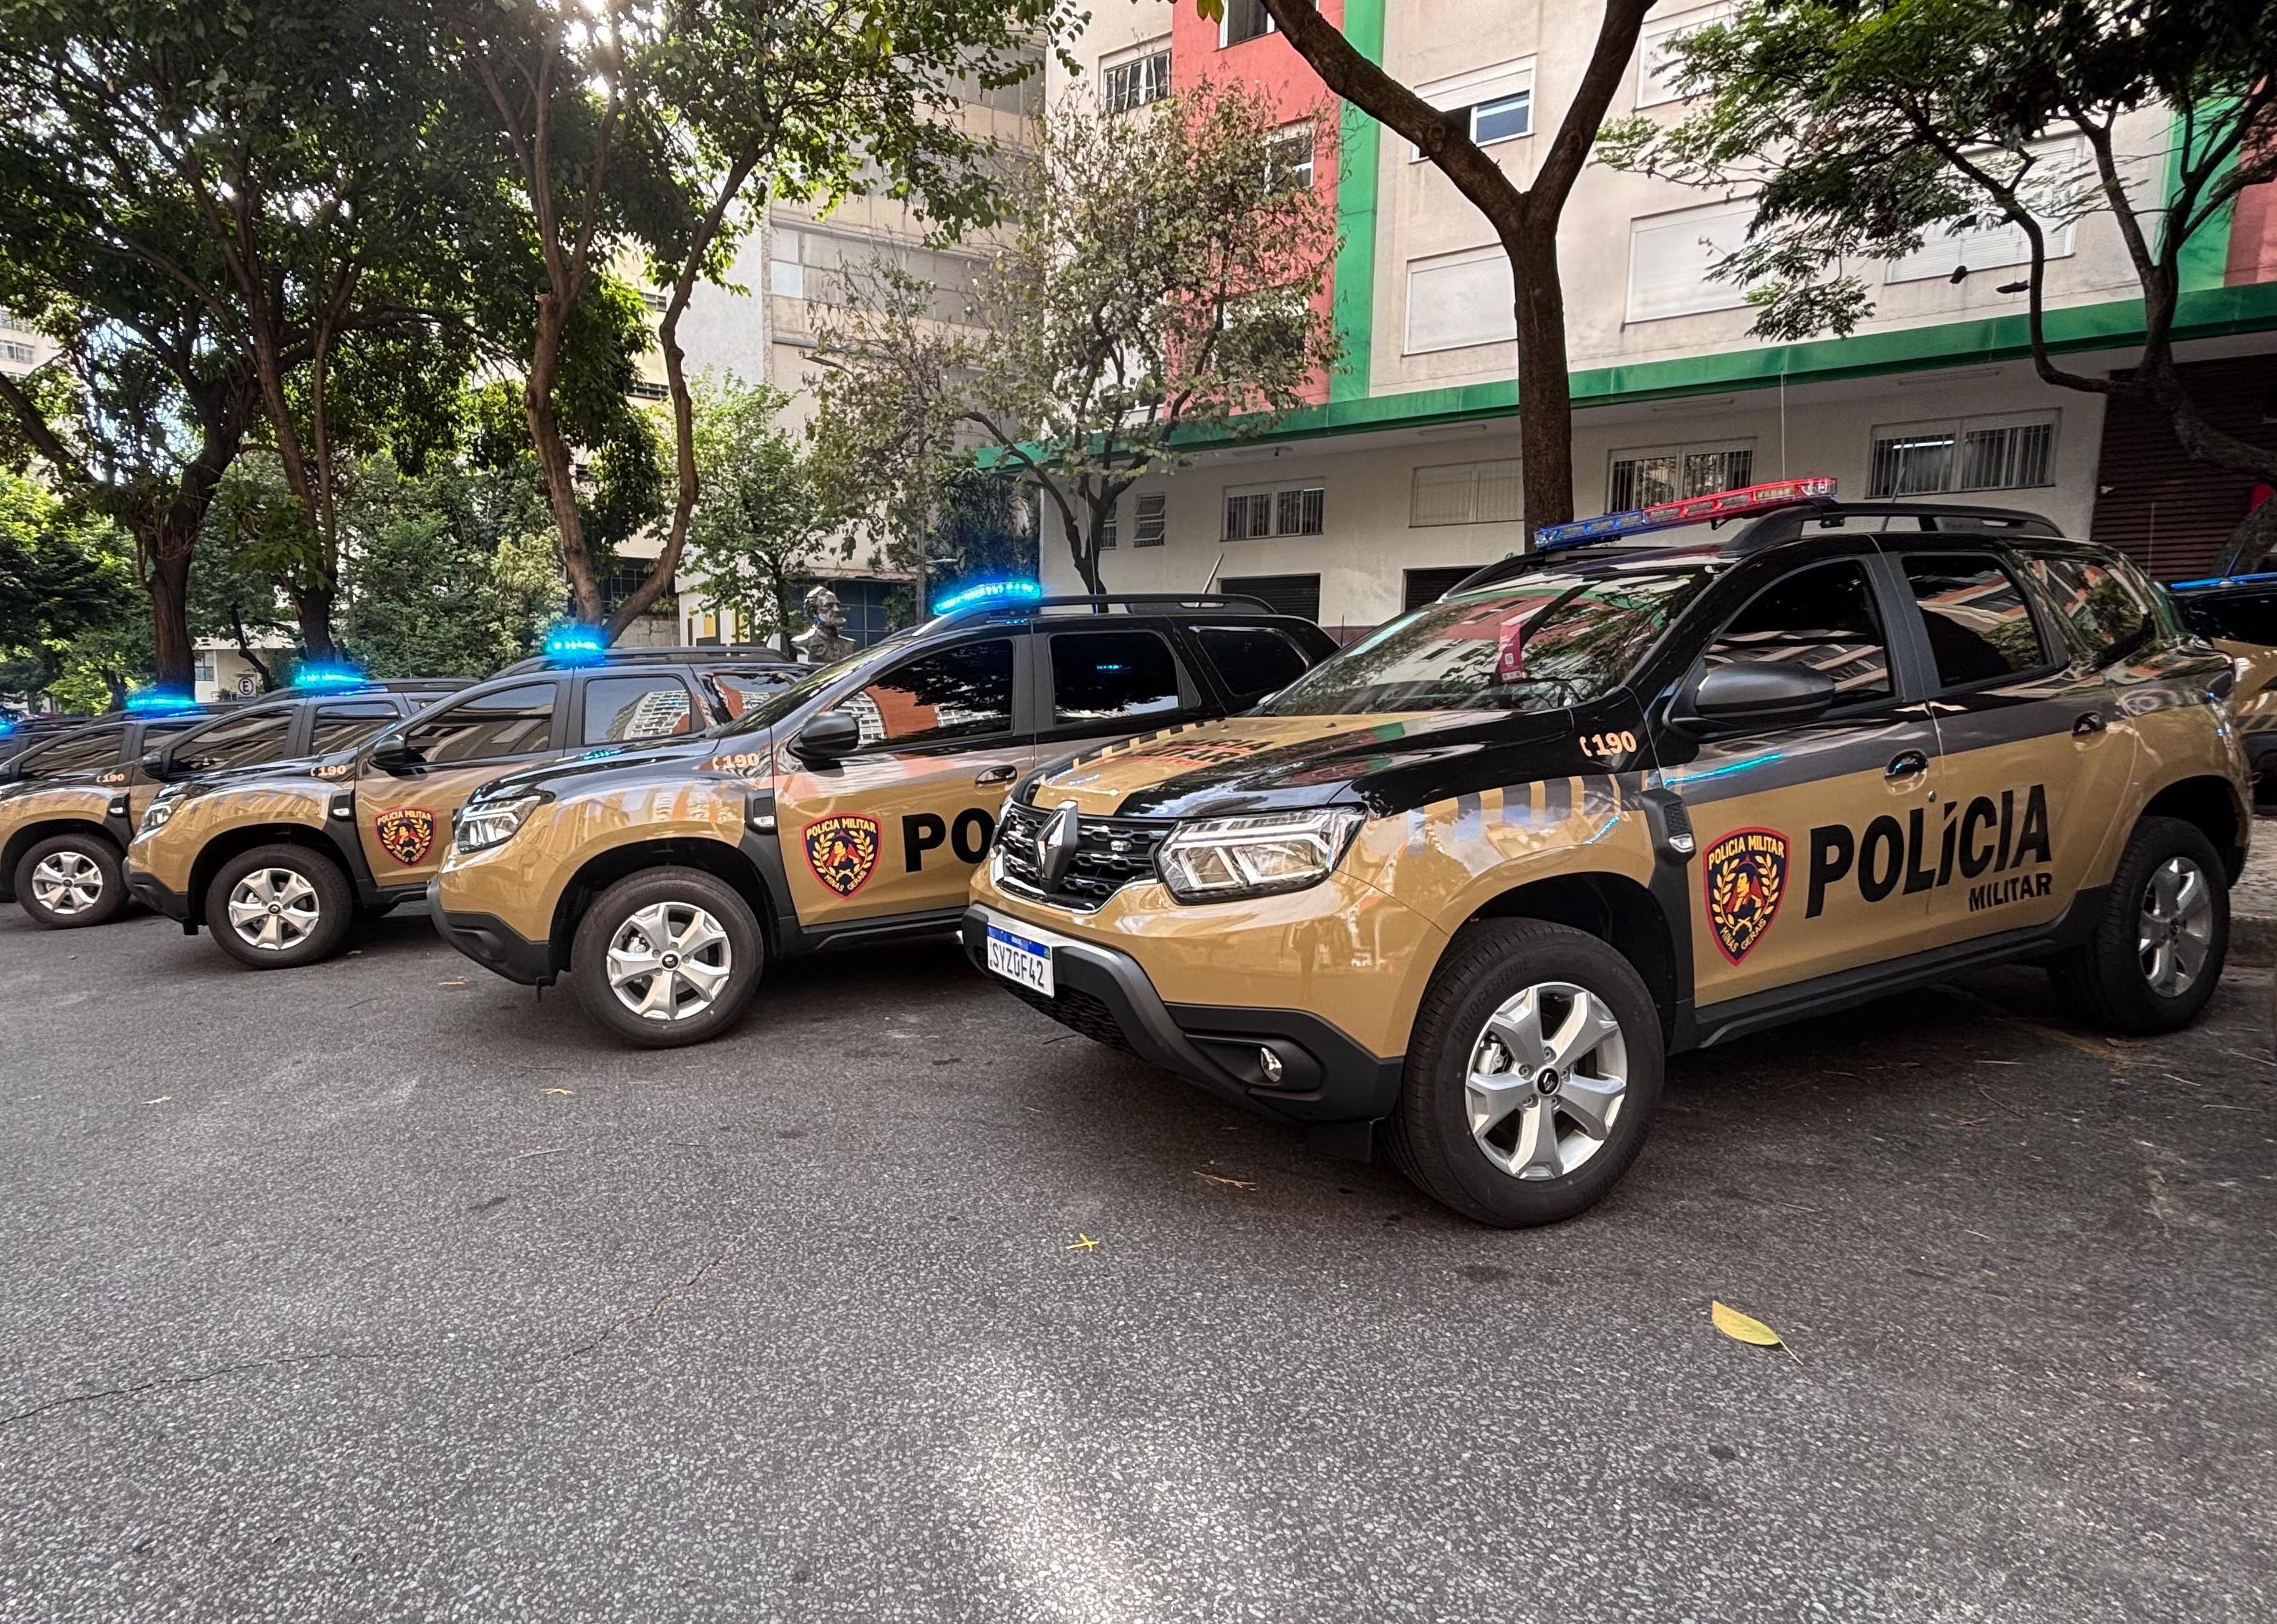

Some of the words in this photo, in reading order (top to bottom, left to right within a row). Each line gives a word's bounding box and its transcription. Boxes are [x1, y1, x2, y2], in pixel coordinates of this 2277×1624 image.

[242, 680, 249, 692] E
[1592, 731, 1637, 756] 190
[318, 765, 347, 777] 190
[722, 753, 760, 769] 190
[102, 773, 125, 783] 190
[841, 818, 877, 833] MILITAR
[901, 805, 1002, 873] PO
[1748, 835, 1785, 859] MILITAR
[1805, 783, 2052, 919] POLÍCIA
[823, 874, 845, 892] MINAS
[1969, 872, 2053, 912] MILITAR
[1719, 926, 1739, 952] MINAS
[1741, 918, 1767, 950] GERAIS
